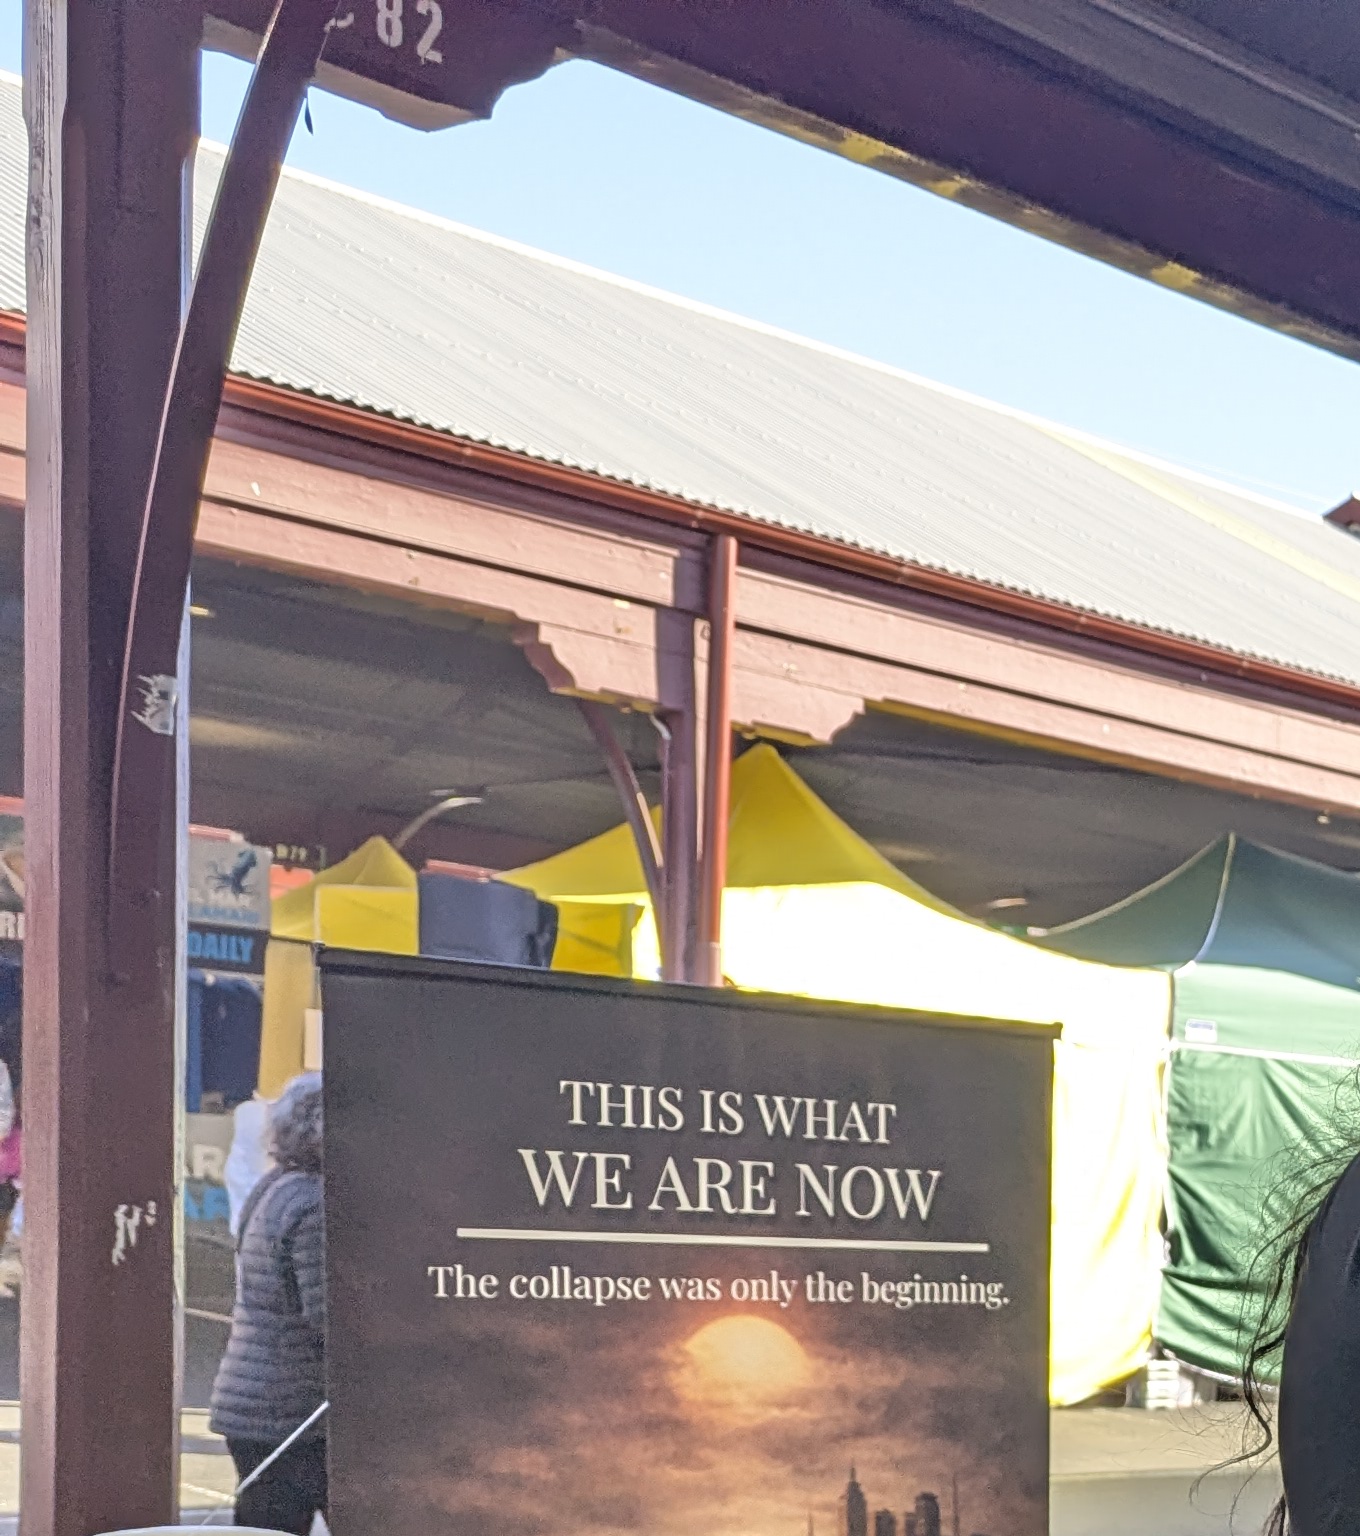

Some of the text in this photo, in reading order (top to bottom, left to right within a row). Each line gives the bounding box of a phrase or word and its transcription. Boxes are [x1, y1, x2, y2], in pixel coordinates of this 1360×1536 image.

[323, 0, 443, 64] 82
[559, 1079, 897, 1145] THIS IS WHAT
[517, 1148, 943, 1222] WE ARE NOW
[428, 1264, 1010, 1311] The collapse was only the beginning.
